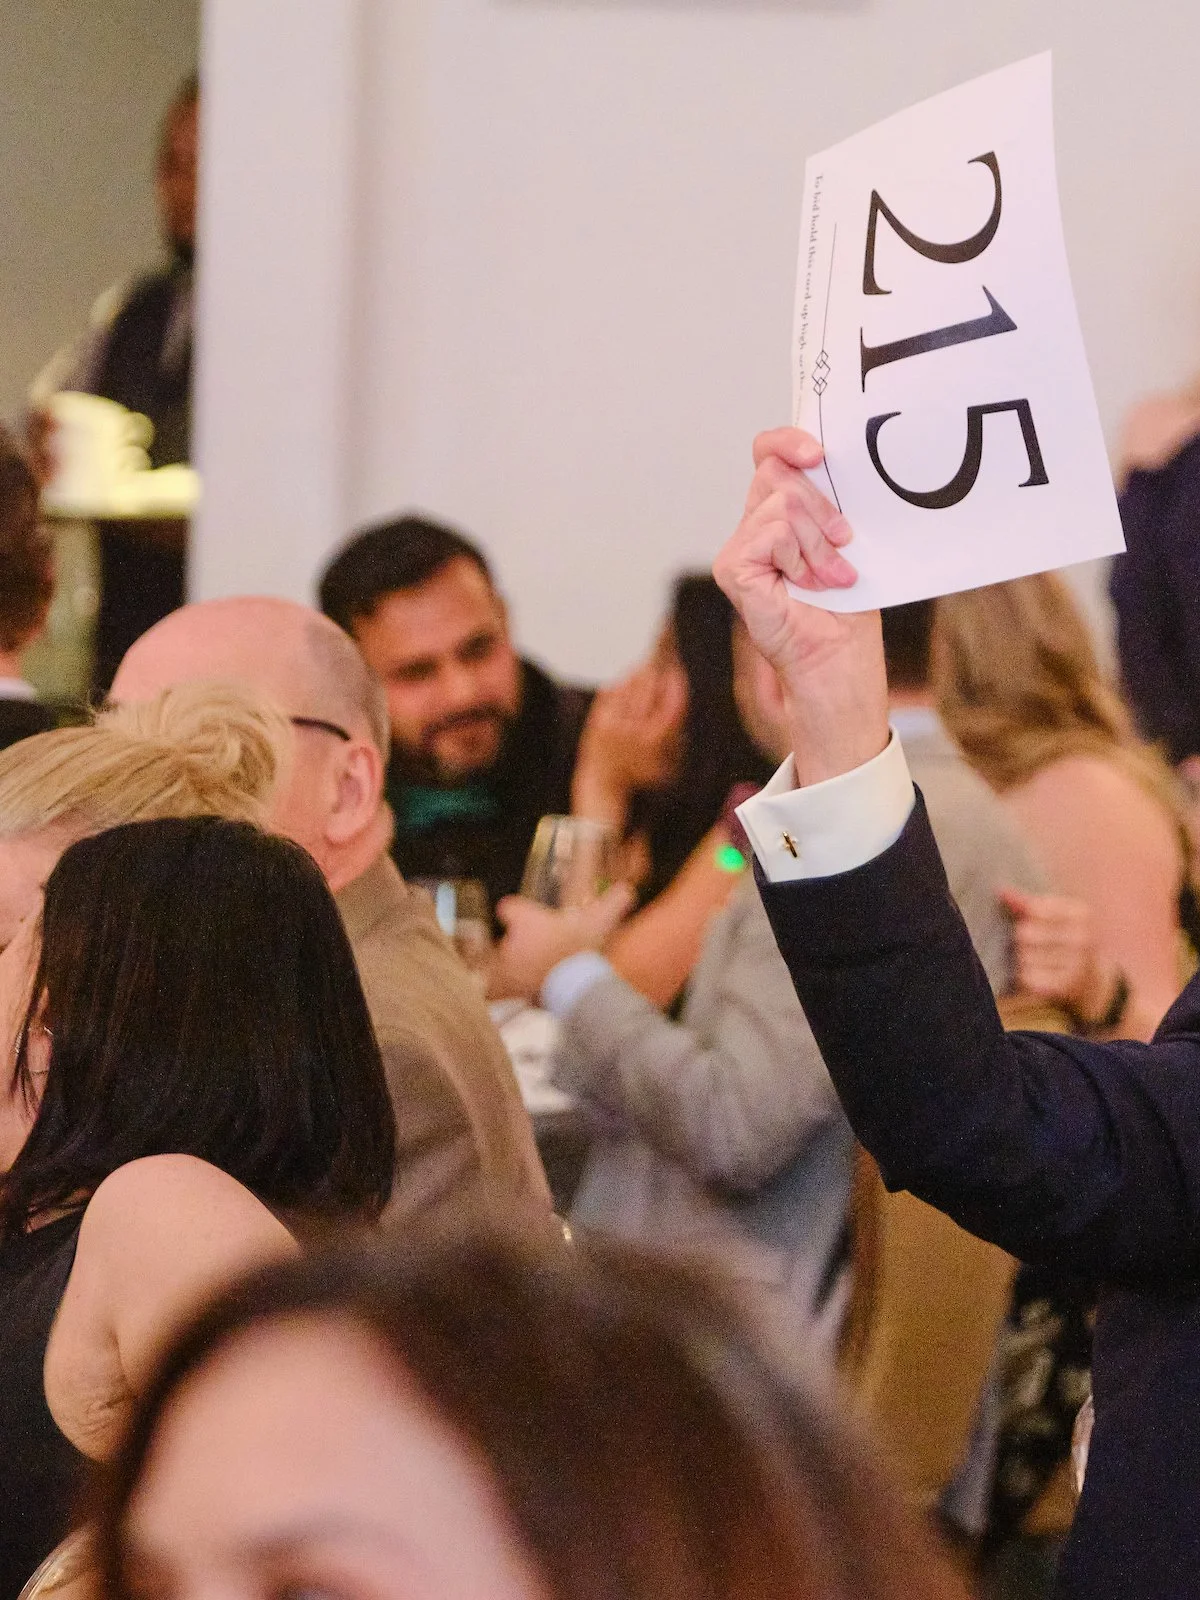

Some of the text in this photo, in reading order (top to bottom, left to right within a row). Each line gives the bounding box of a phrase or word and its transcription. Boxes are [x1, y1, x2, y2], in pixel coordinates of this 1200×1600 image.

[812, 191, 822, 212] bid
[809, 214, 820, 243] hold
[807, 245, 816, 269] this
[804, 271, 812, 300] card
[800, 302, 809, 320] up
[799, 322, 809, 351] high
[860, 150, 1050, 510] 215
